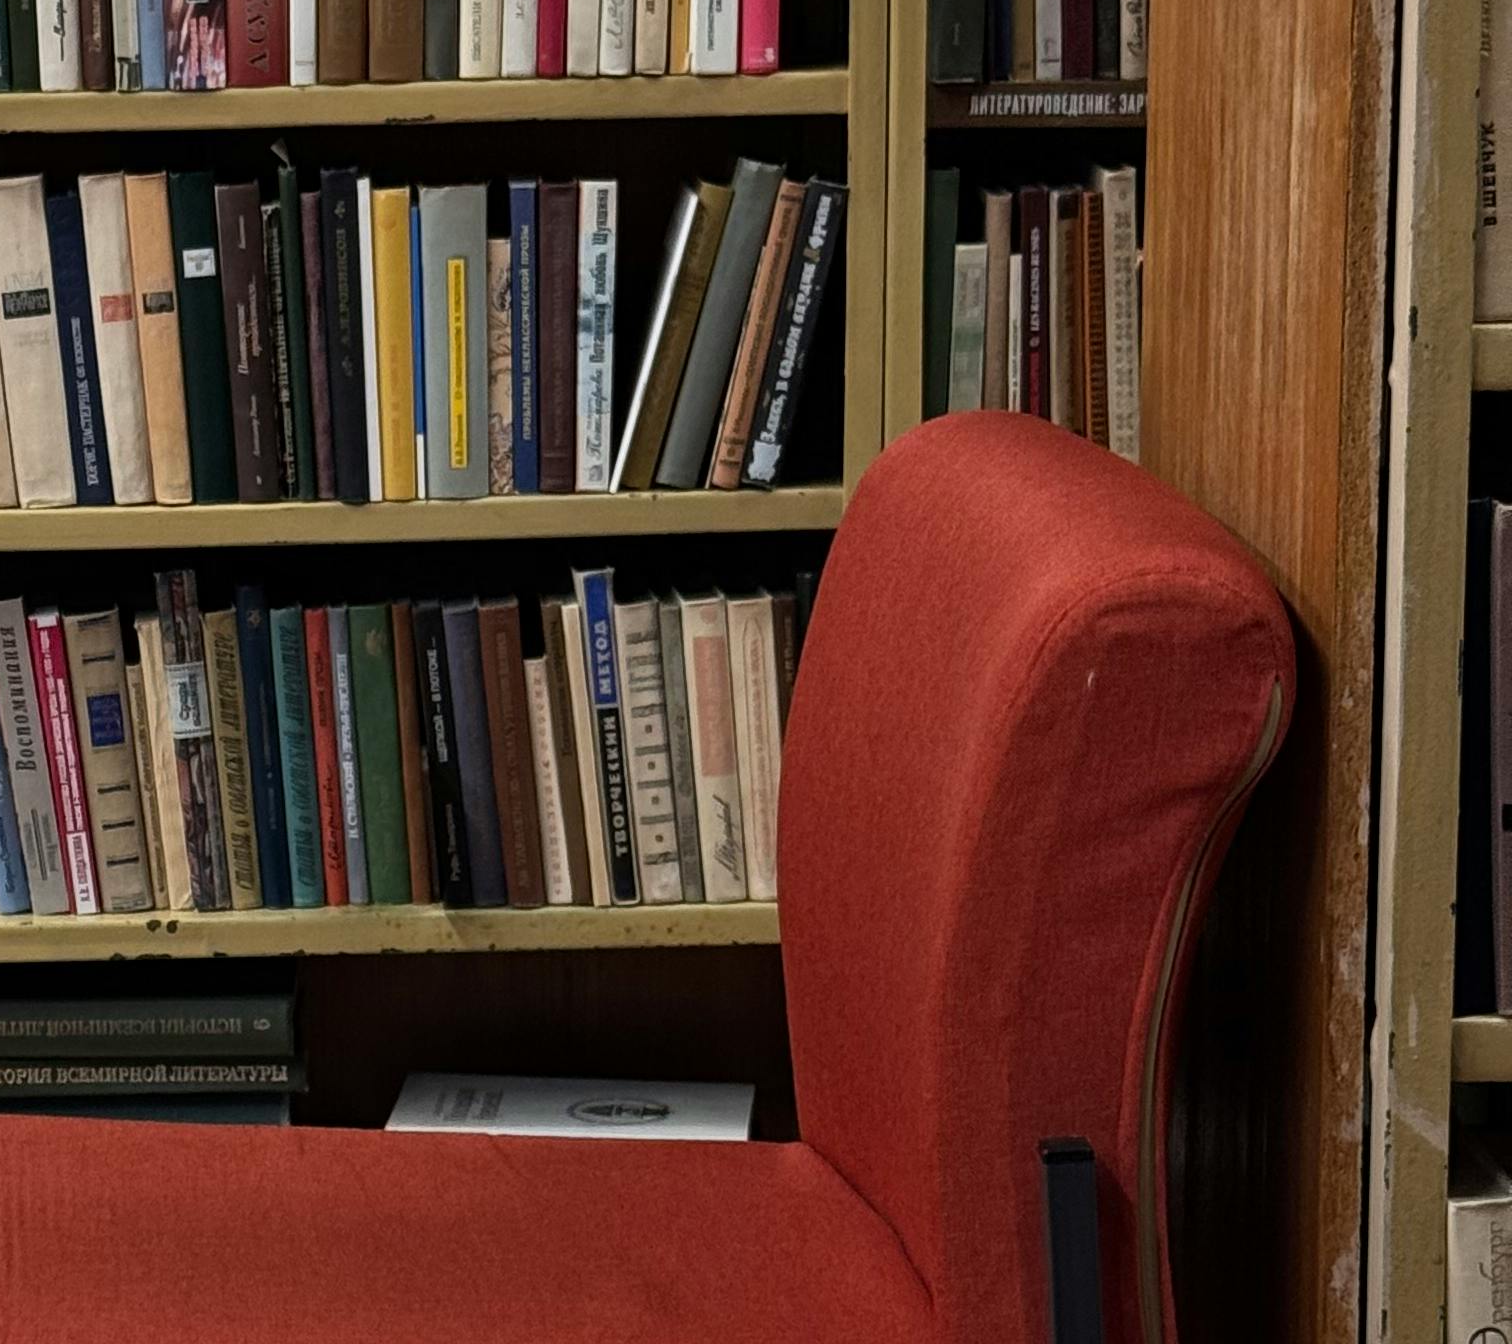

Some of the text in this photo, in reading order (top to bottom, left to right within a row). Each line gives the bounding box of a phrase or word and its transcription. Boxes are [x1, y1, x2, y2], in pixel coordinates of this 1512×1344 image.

[249, 49, 271, 72] А
[1479, 120, 1497, 208] ШЕВЧУК
[0, 625, 38, 771] Воспоминания
[592, 619, 630, 857] ТВОРЧЕСКИЙ МЕТОД
[55, 1063, 165, 1085] ВСЕМИРНОЙ
[169, 1065, 288, 1083] ЛИТЕРАТУРЫ
